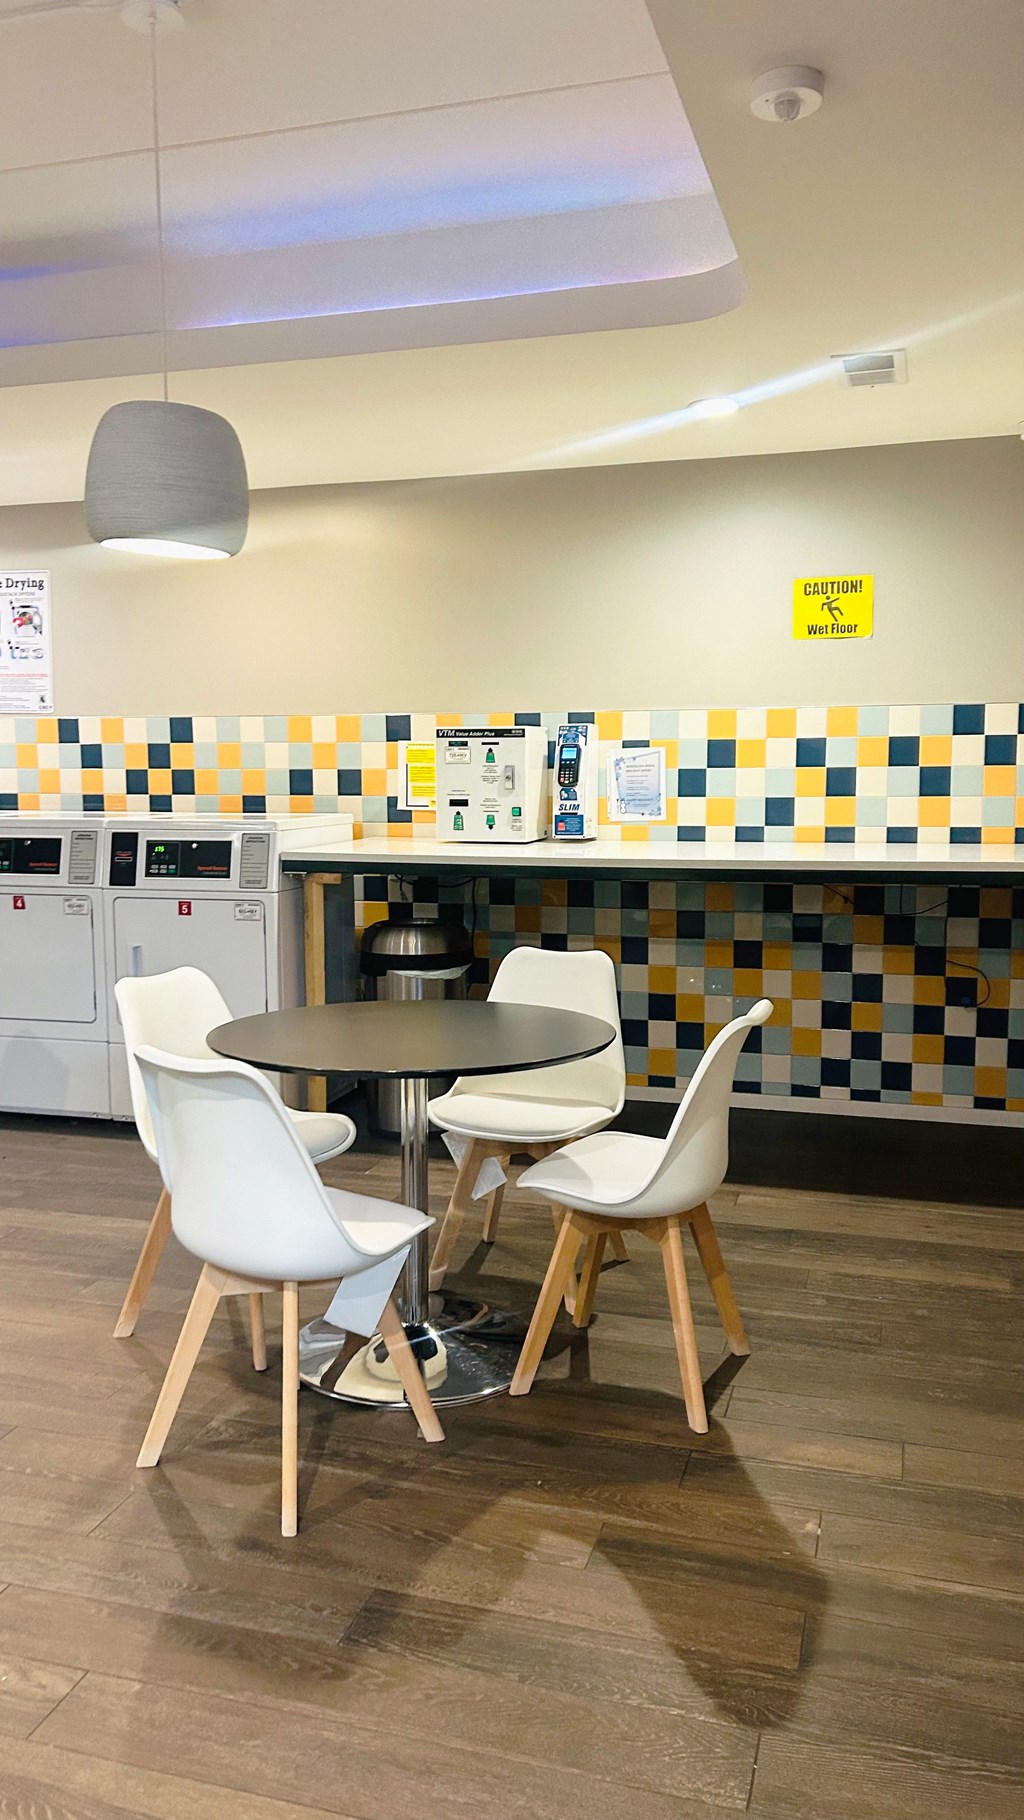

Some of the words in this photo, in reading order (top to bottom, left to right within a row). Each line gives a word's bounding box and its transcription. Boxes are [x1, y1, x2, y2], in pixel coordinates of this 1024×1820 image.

[5, 577, 45, 591] Drying
[804, 580, 863, 596] CAUTION!
[807, 624, 829, 635] Wet
[831, 623, 858, 634] Floor
[438, 729, 455, 737] VTM
[16, 899, 23, 908] 4
[181, 904, 188, 914] 5
